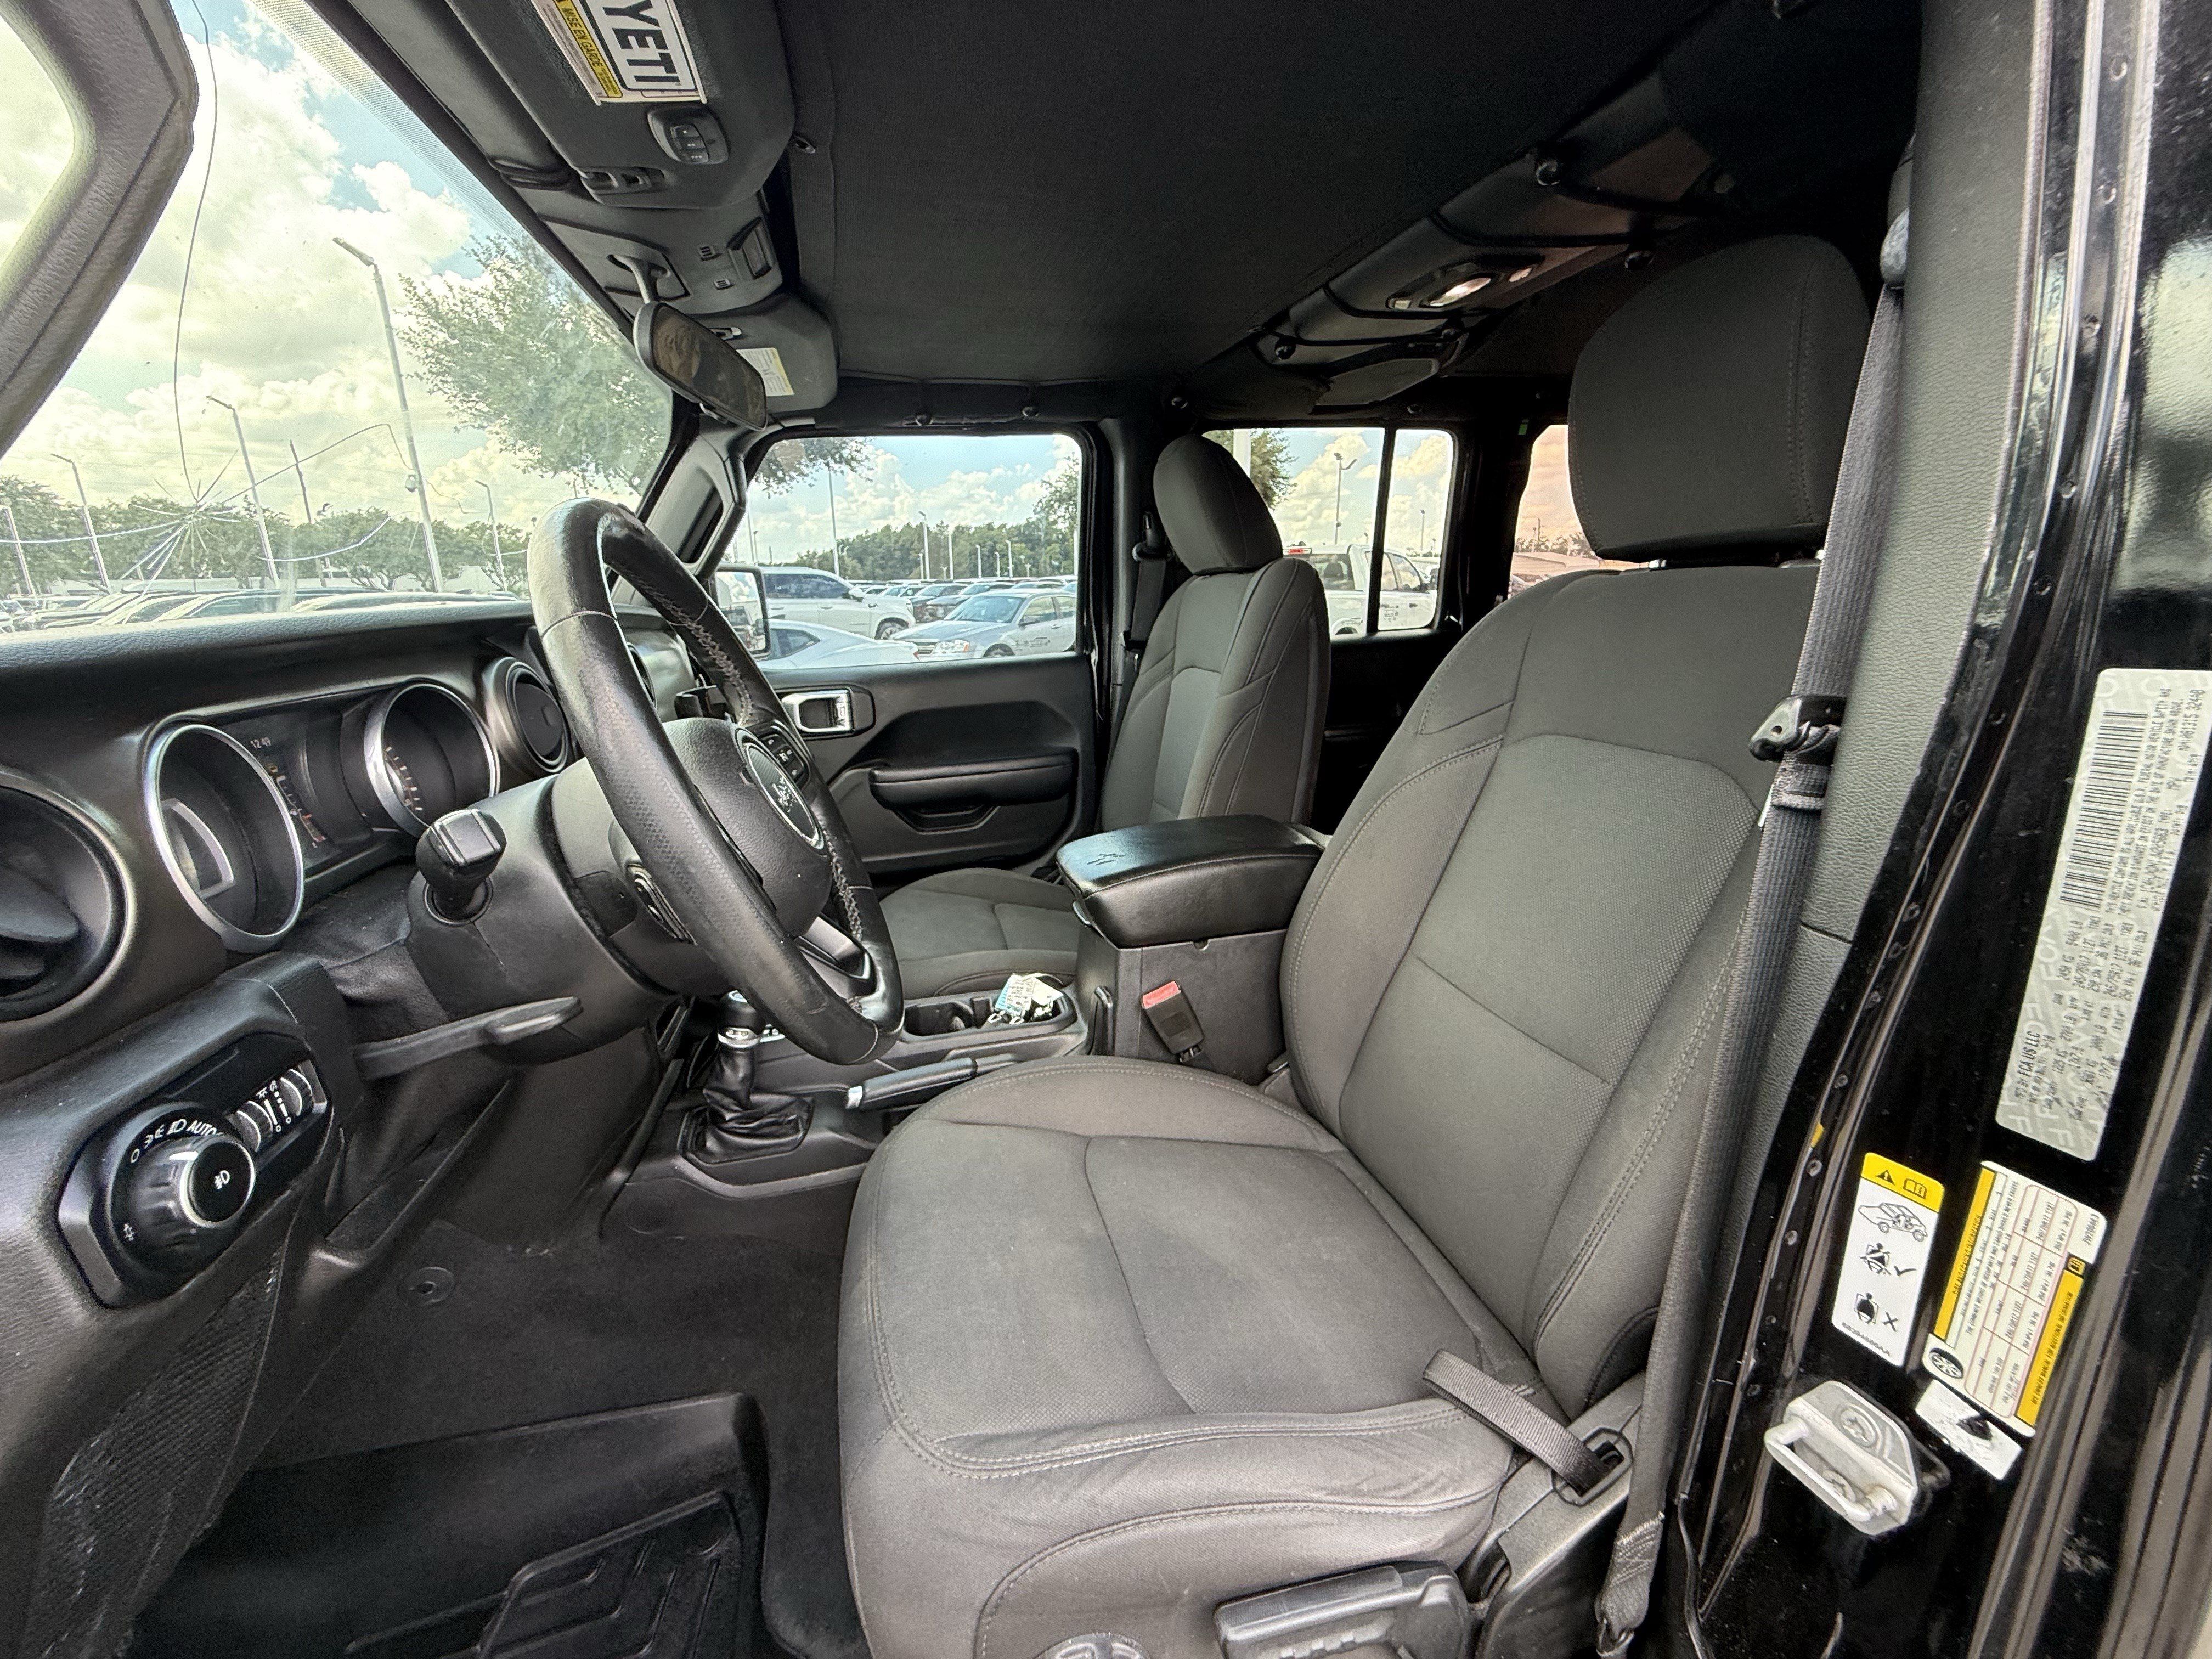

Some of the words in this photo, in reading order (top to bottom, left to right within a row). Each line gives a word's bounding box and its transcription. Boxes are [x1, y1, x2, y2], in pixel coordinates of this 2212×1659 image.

[562, 7, 579, 29] MISE
[573, 26, 588, 41] EN
[602, 0, 681, 82] YETI
[580, 39, 603, 67] GARDE
[2023, 1029, 2041, 1048] LLC
[2020, 1046, 2038, 1060] US
[2016, 1058, 2034, 1077] FCA
[186, 1120, 217, 1136] AUTO
